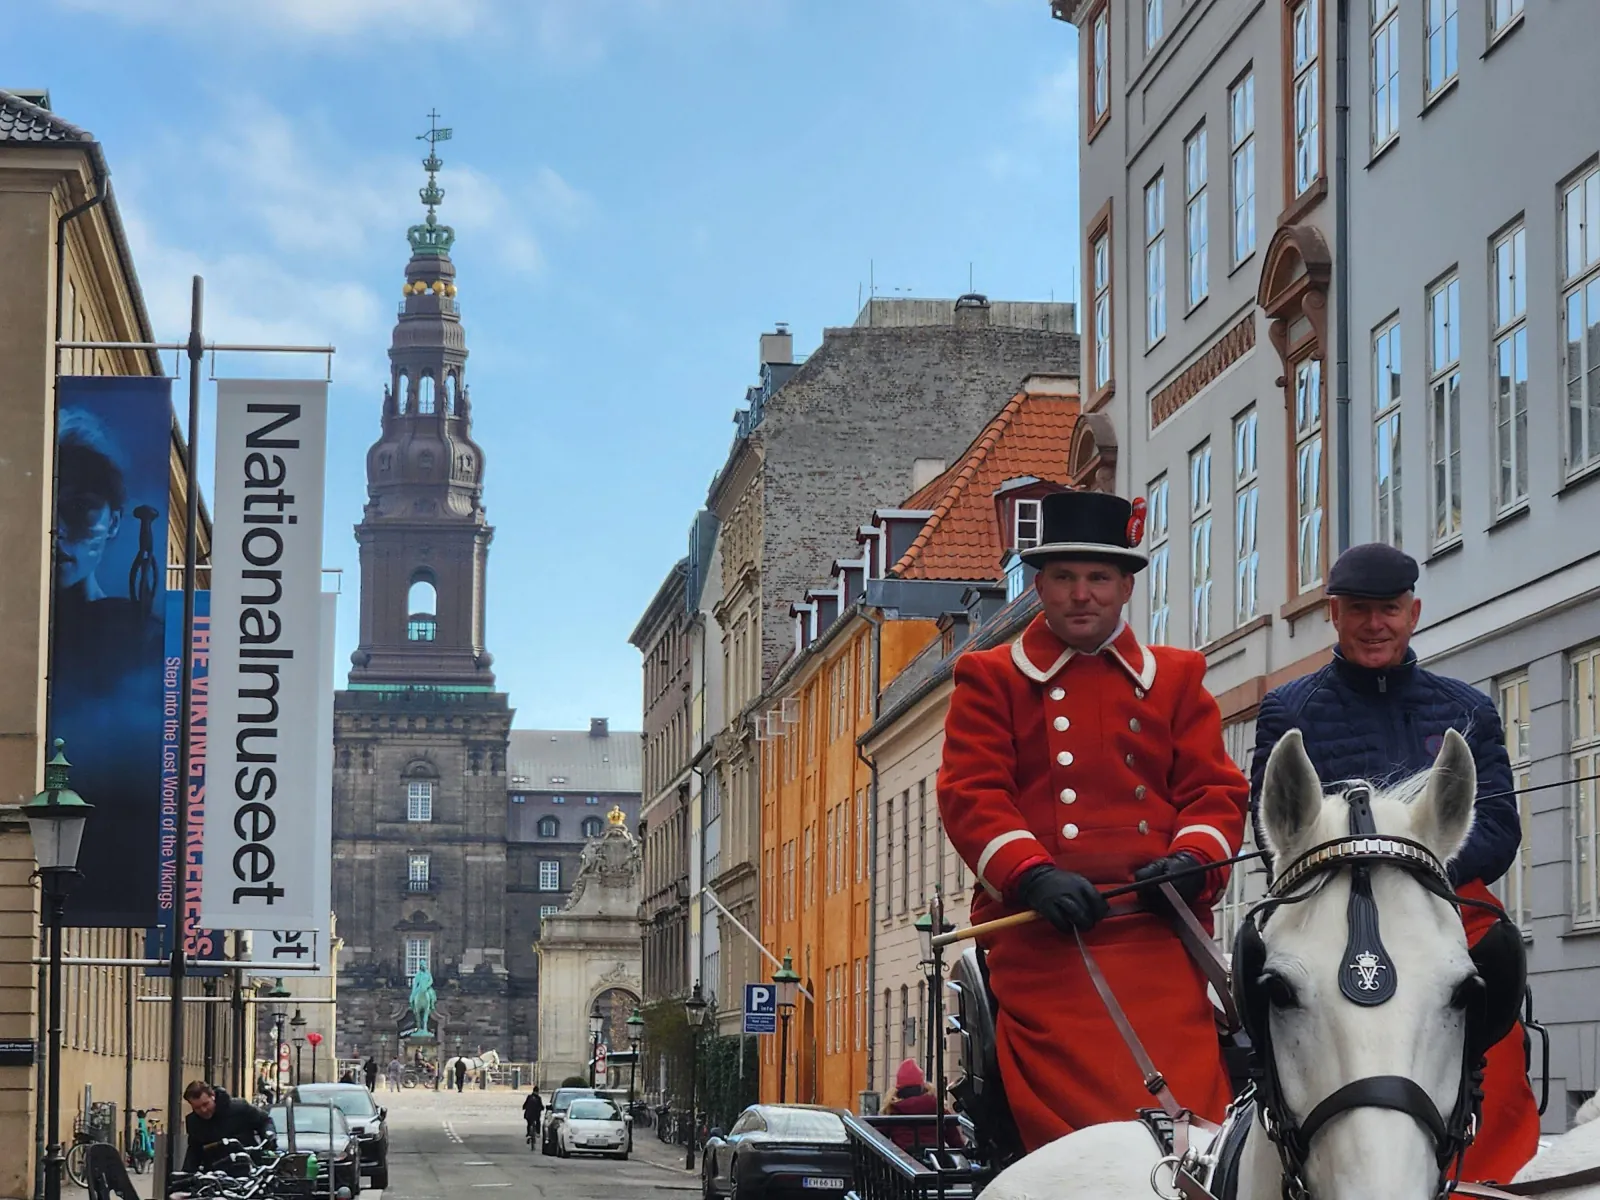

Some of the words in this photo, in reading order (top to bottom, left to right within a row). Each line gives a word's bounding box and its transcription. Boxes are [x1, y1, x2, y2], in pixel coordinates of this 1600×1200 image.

[232, 403, 301, 906] Nationalmuseet
[164, 656, 181, 688] Step
[164, 691, 181, 717] into
[163, 720, 180, 742] the
[189, 676, 209, 776] VIKING
[163, 744, 179, 773] Lost
[162, 776, 179, 815] World
[162, 818, 178, 832] of
[161, 835, 178, 857] the
[157, 860, 177, 909] Vikings
[752, 986, 770, 1012] P
